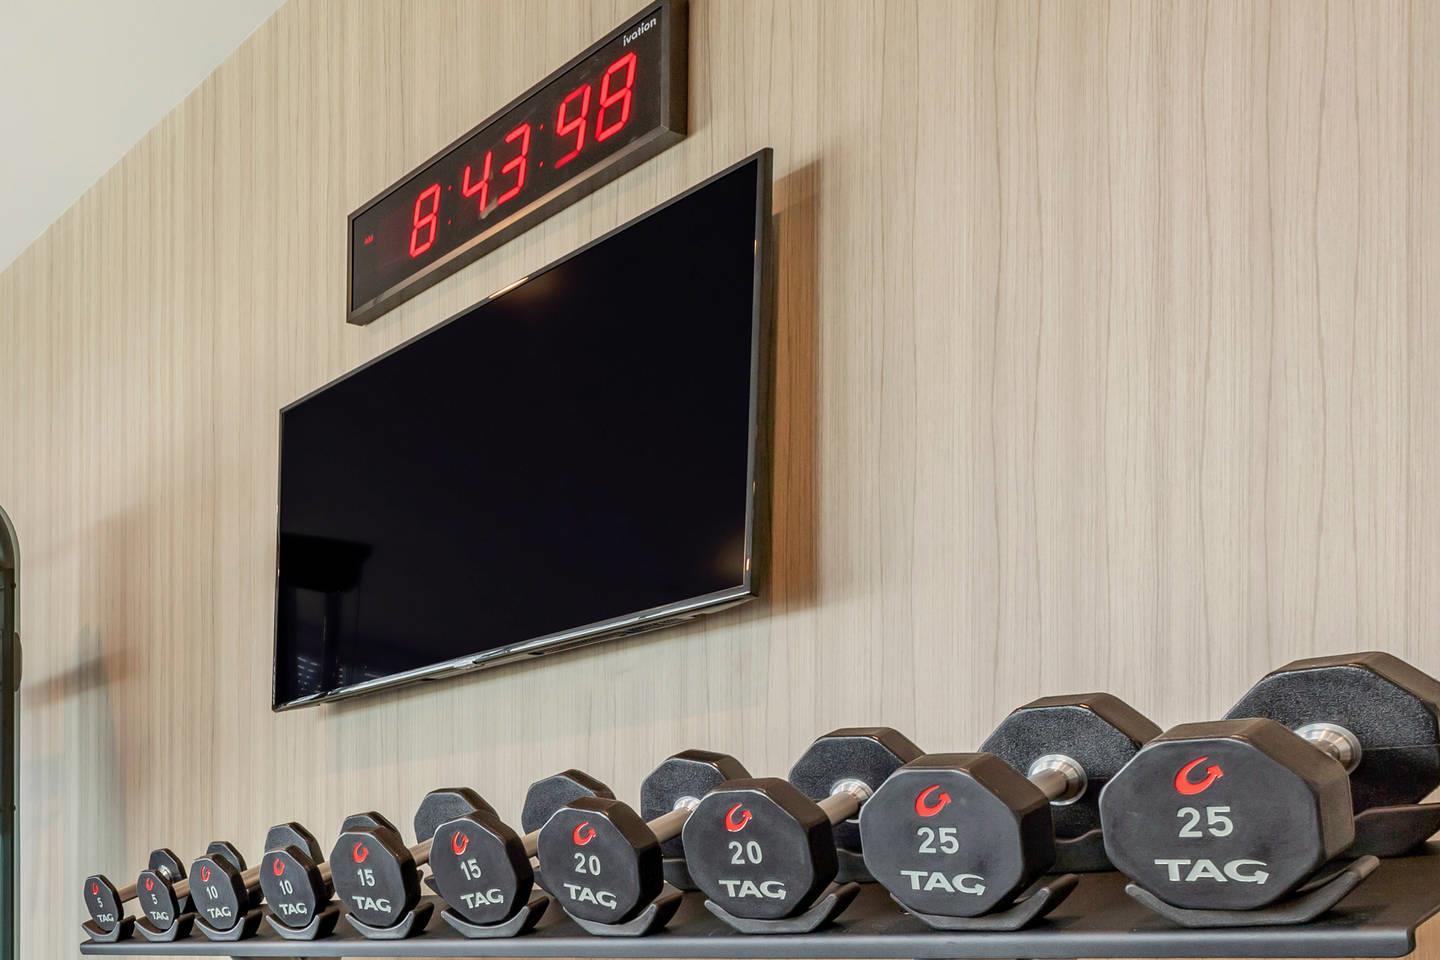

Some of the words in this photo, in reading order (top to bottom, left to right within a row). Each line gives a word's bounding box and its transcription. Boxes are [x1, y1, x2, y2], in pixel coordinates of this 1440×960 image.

[623, 18, 657, 46] ivation
[1177, 806, 1234, 838] 25
[917, 827, 959, 854] 25
[728, 840, 763, 865] 20
[460, 859, 481, 881] 15
[574, 852, 601, 876] 20
[1155, 859, 1270, 885] TAG
[279, 880, 293, 896] 10
[357, 869, 375, 888] 15
[900, 870, 987, 896] TAG
[151, 894, 158, 905] 5
[206, 886, 218, 900] 10
[460, 888, 504, 909] TAG
[563, 883, 617, 910] TAG
[719, 879, 787, 900] TAG
[98, 897, 103, 908] 5
[207, 907, 232, 919] TAG
[279, 902, 308, 916] TAG
[352, 896, 392, 913] TAG
[97, 914, 114, 922] TAG
[150, 911, 169, 922] TAG
